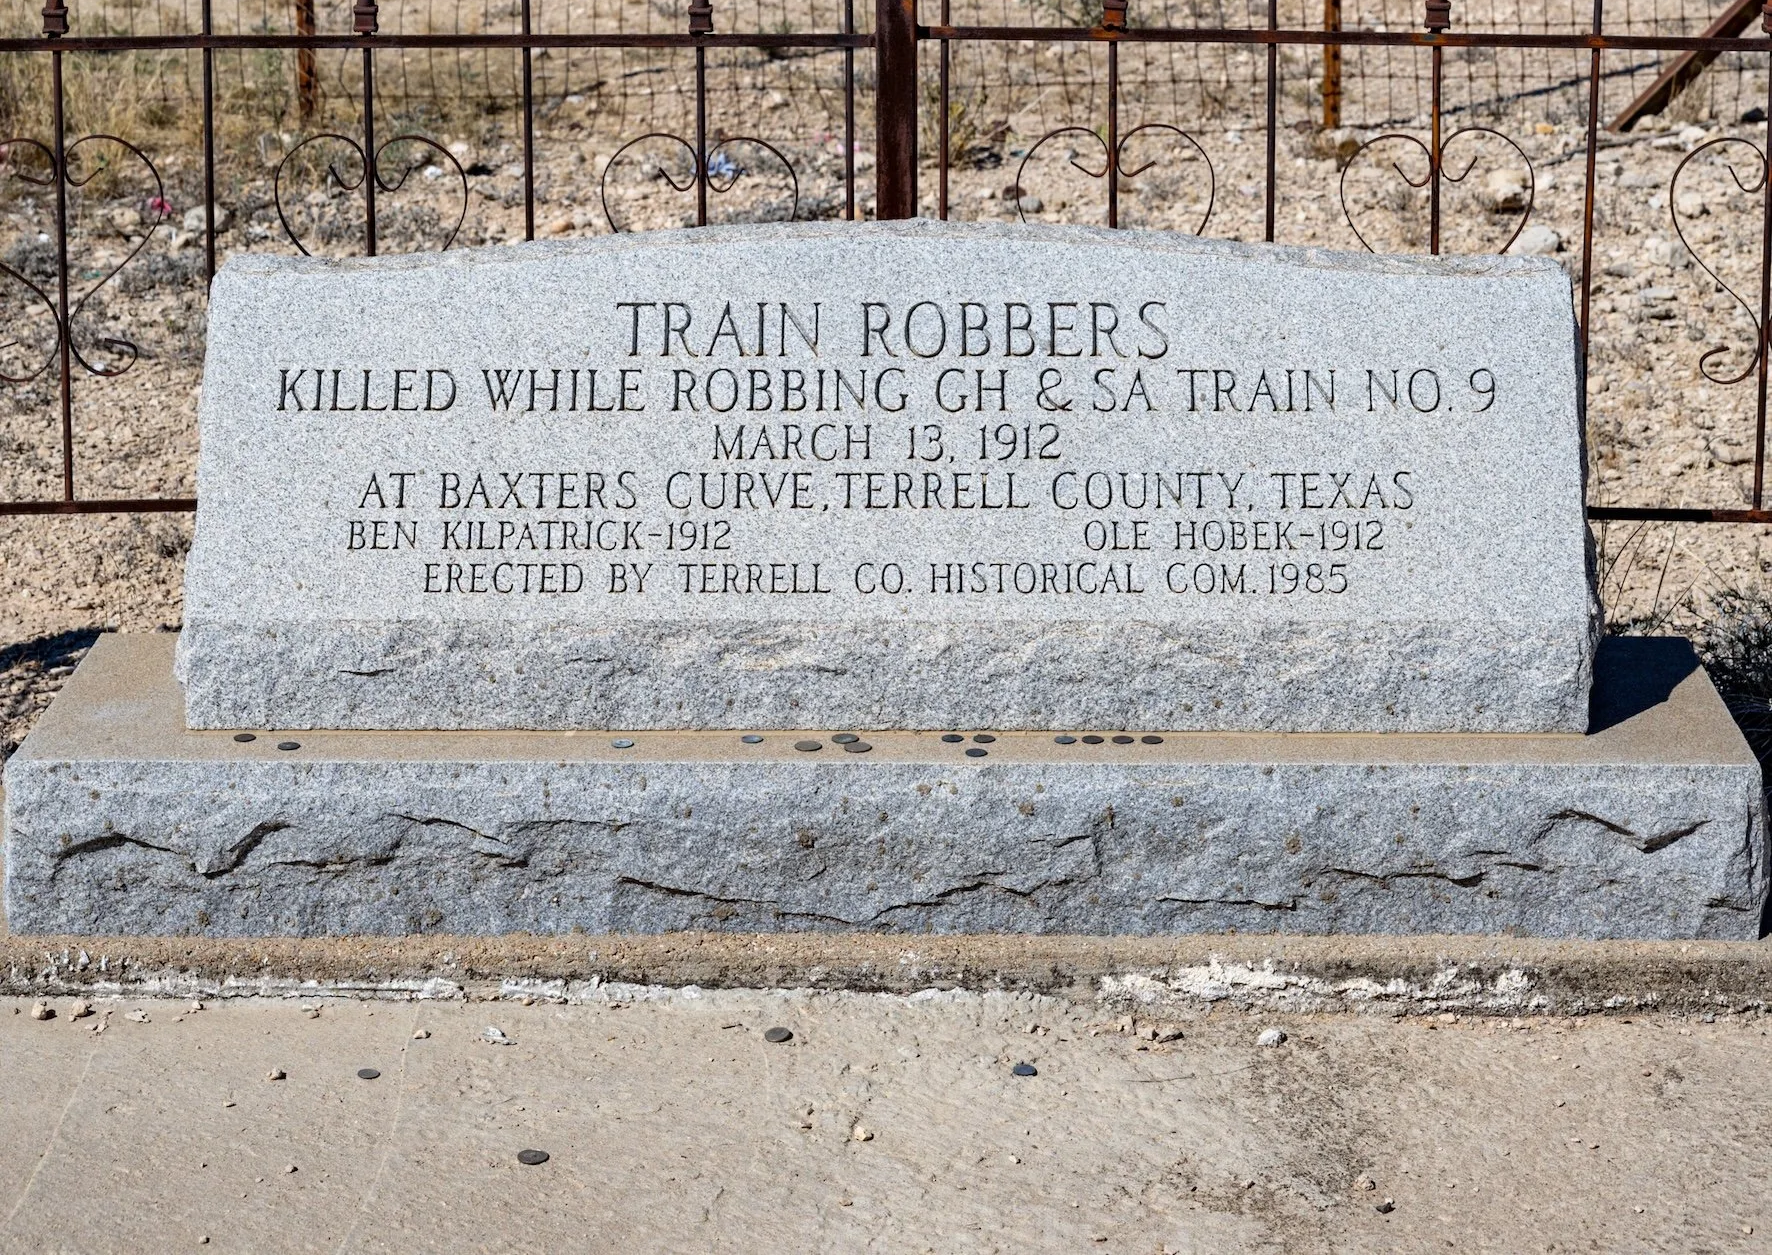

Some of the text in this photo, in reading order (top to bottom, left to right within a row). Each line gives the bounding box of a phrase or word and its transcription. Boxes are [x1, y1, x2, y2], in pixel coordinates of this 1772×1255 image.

[615, 300, 1169, 361] TRAIN ROBBERS
[276, 368, 458, 413] KILLED
[480, 368, 646, 413] WHILE
[670, 366, 909, 414] ROBBING
[934, 367, 1009, 414] GH
[1035, 367, 1073, 413] &
[1092, 367, 1159, 413] SA
[1176, 368, 1336, 413] TRAIN
[712, 422, 1062, 464] MARCH 13, 1912
[357, 471, 416, 510] AT
[438, 469, 637, 511] BAXTERS
[1051, 470, 1254, 513] COUNTY,
[1269, 470, 1414, 511] TEXAS
[346, 519, 419, 553] BEN
[1083, 519, 1152, 552] OLE
[423, 560, 584, 595] ERECTED
[608, 562, 654, 594] BY
[677, 562, 832, 595] TERRELL
[854, 561, 912, 595] CO.
[929, 560, 1145, 595] HISTORICAL
